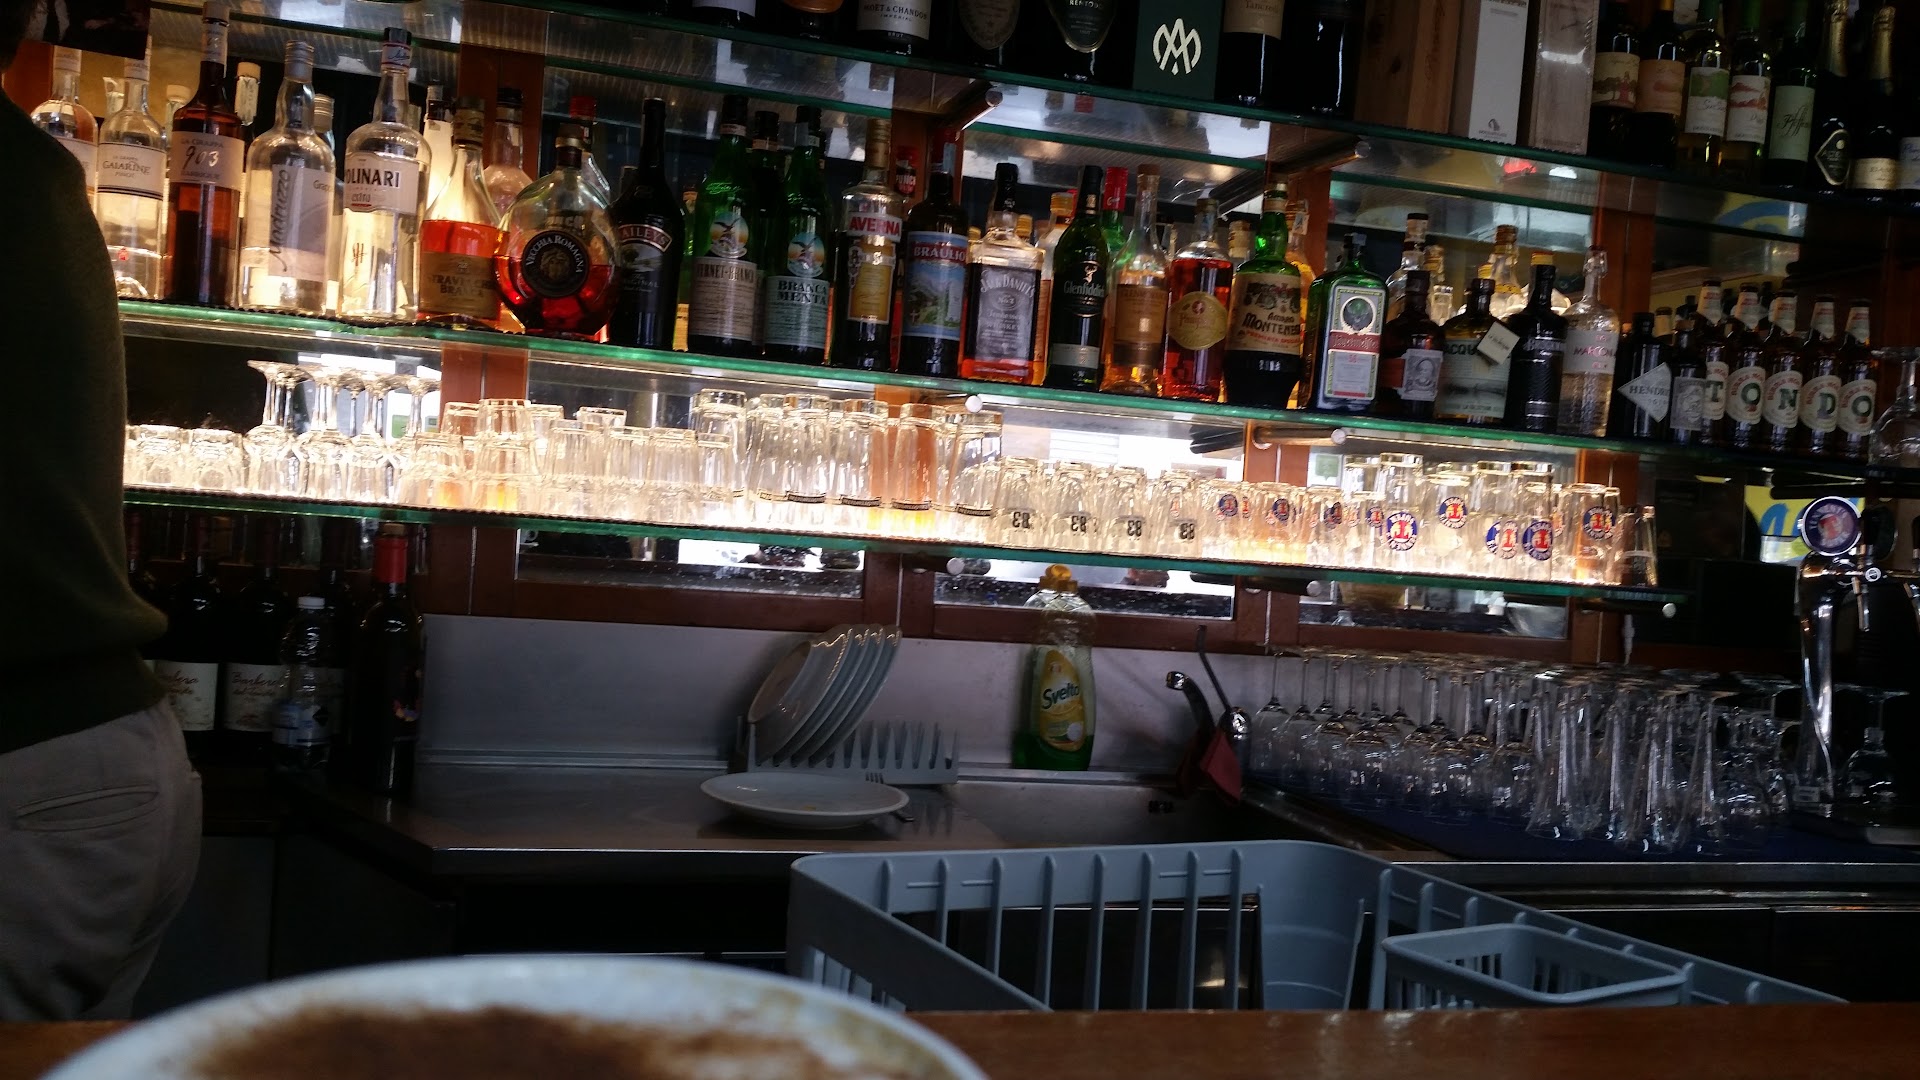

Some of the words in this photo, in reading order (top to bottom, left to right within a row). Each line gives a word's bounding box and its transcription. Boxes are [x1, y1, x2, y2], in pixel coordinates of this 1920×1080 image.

[182, 145, 220, 170] 903
[345, 167, 400, 188] OLINARI
[621, 226, 666, 245] AILEYS
[1705, 380, 1724, 403] T
[1741, 382, 1761, 406] O
[1778, 388, 1799, 411] N
[1817, 392, 1836, 419] D
[1852, 395, 1873, 417] O
[1042, 682, 1080, 710] Svelto
